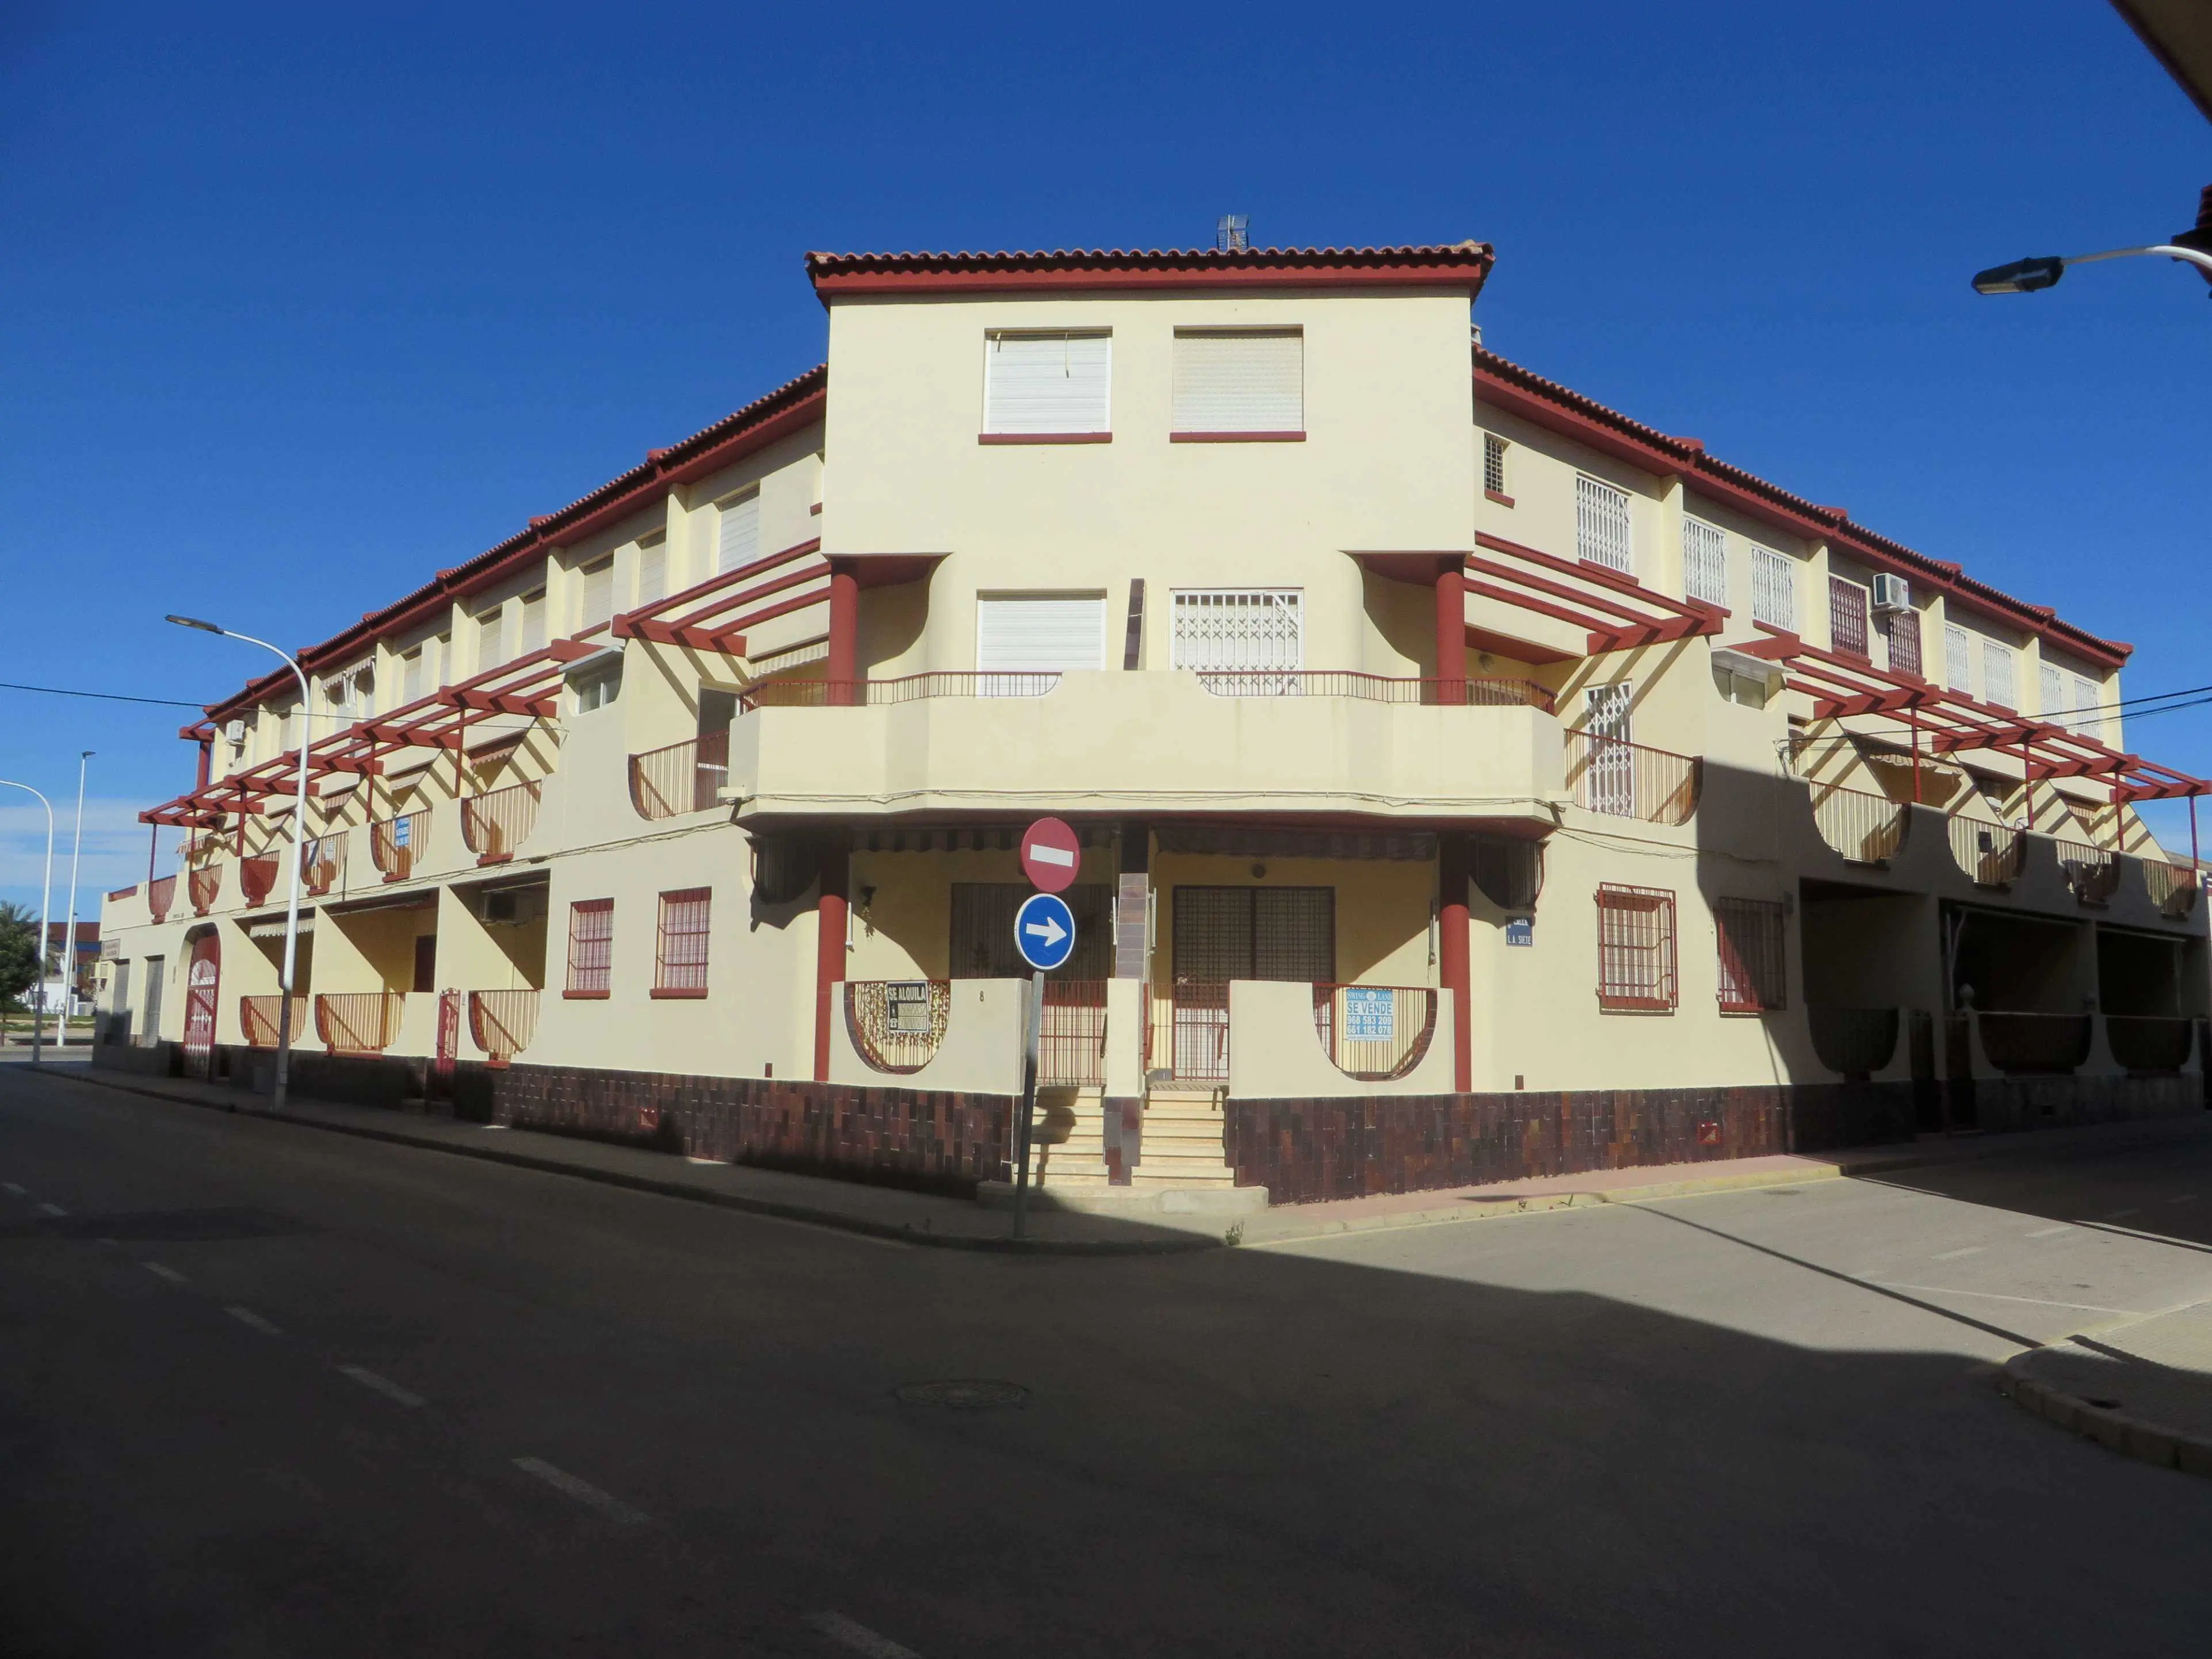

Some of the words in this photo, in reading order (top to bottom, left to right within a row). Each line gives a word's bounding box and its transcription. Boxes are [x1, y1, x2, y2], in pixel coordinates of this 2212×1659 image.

[888, 987, 897, 1001] SE
[899, 986, 926, 1001] ALQUILA
[980, 991, 984, 1002] 8
[1348, 1002, 1358, 1014] SE
[1362, 1002, 1392, 1014] VENDE
[1347, 1016, 1361, 1025] 968
[1347, 1025, 1361, 1034] 661
[1363, 1025, 1376, 1034] 182
